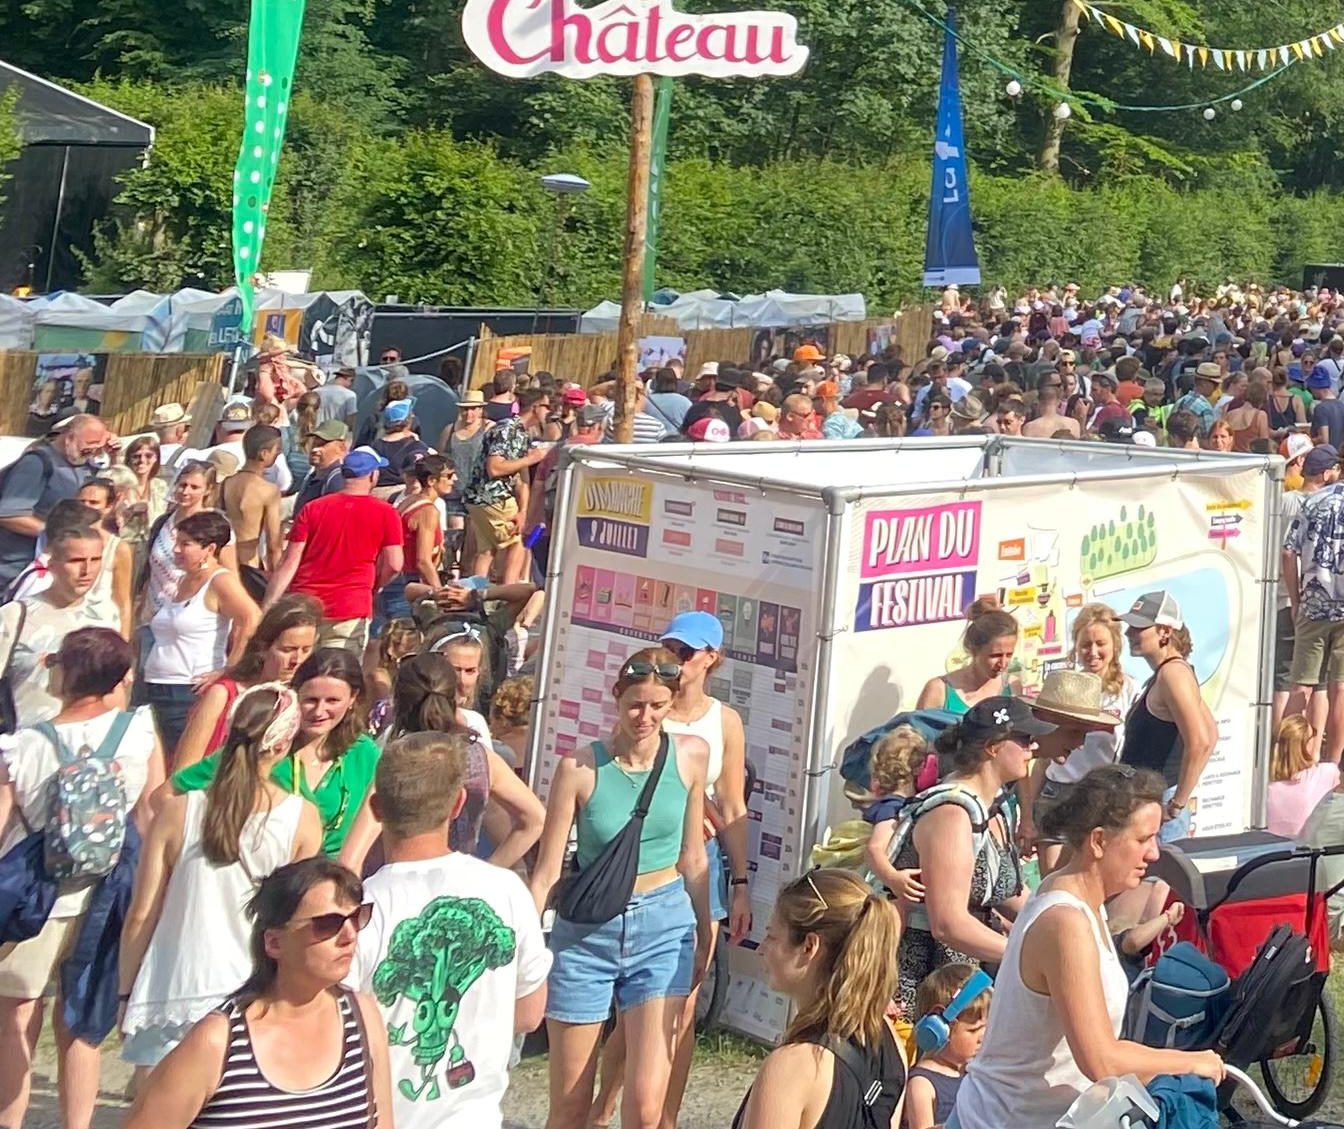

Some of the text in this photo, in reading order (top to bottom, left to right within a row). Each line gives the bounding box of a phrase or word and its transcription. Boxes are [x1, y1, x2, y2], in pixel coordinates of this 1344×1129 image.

[585, 481, 645, 517] DIMANCHE
[590, 519, 597, 543] 9
[599, 521, 638, 551] JUILLET
[868, 508, 975, 568] PLAN DU
[870, 574, 966, 628] FESTIVAL
